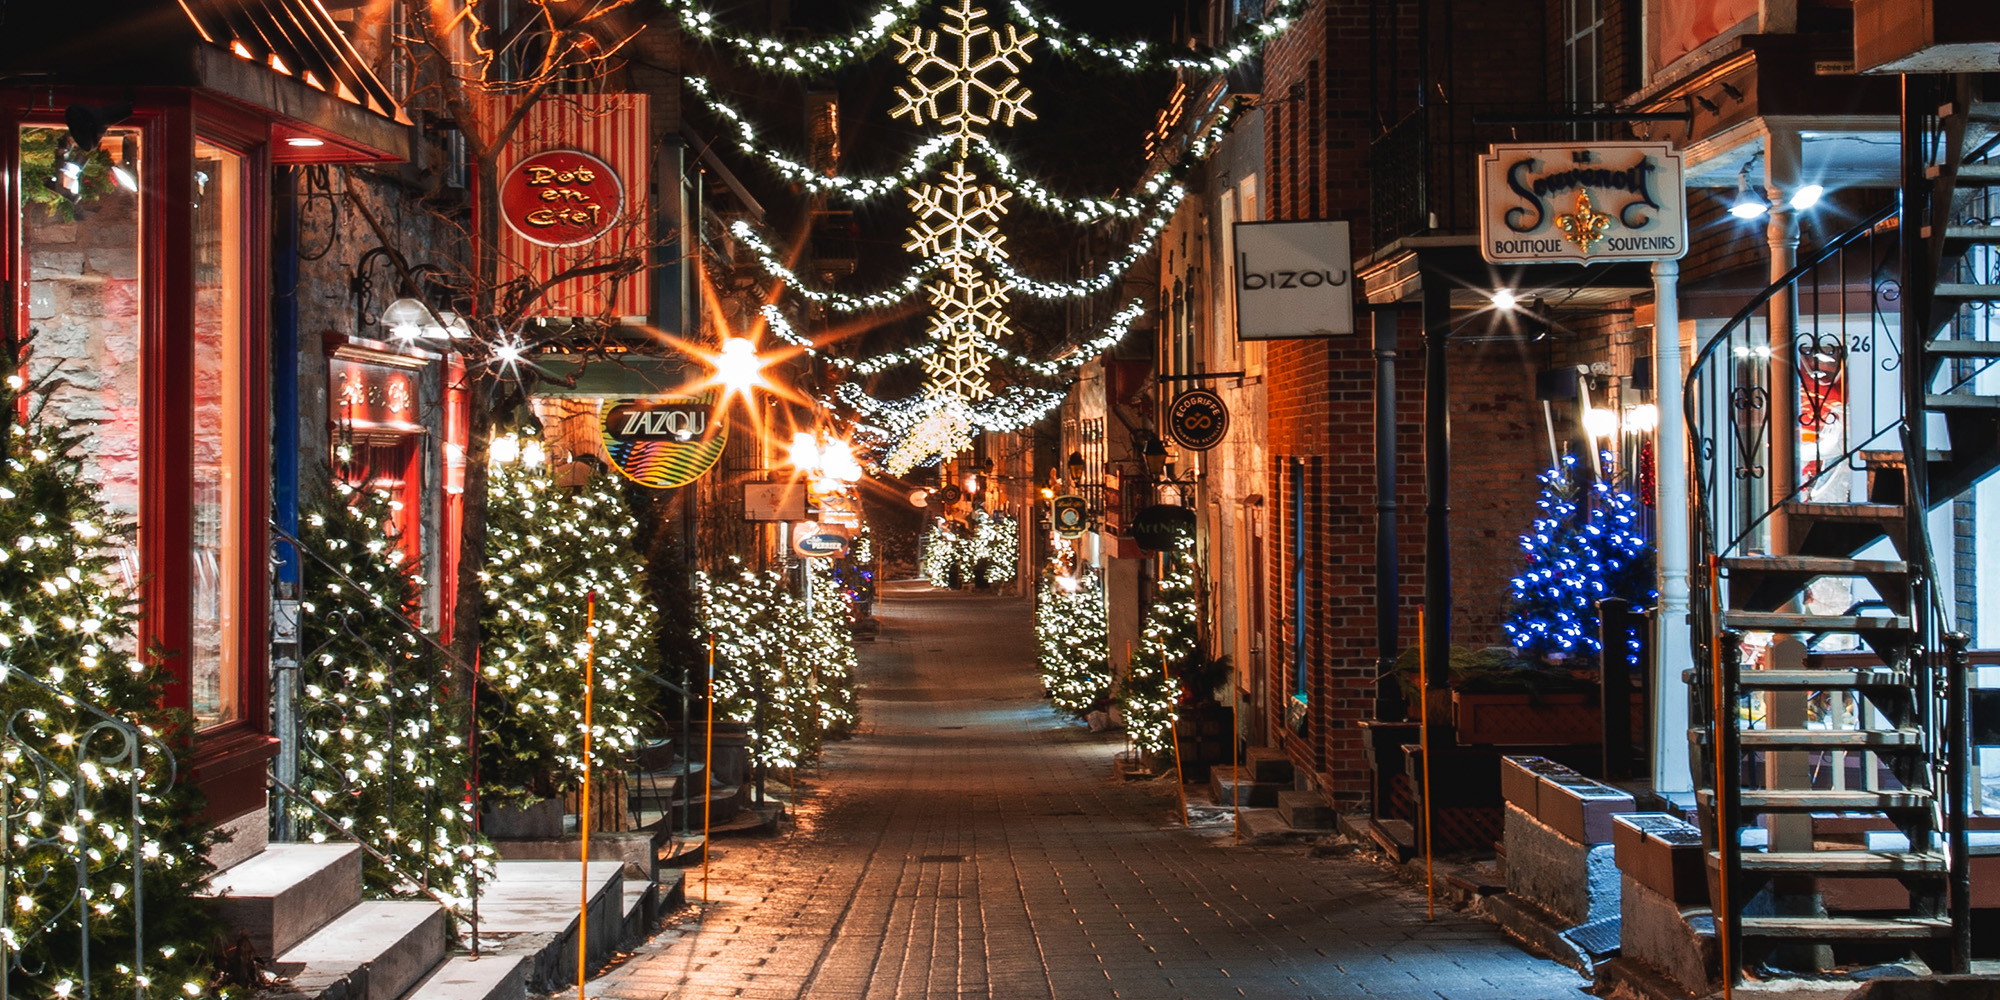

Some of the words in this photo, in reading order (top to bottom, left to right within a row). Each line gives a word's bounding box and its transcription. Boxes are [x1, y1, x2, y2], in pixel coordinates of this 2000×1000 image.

[1572, 150, 1592, 164] LE
[524, 164, 595, 186] Pot
[539, 186, 591, 202] en
[525, 202, 601, 227] Ciel
[1495, 239, 1562, 255] BOUTIQUE
[1607, 236, 1676, 252] SOUVENIRS
[1241, 251, 1347, 291] bizou
[1850, 335, 1871, 353] 26
[1175, 396, 1221, 418] ECOGRIFFE
[620, 410, 706, 436] ZAZOU
